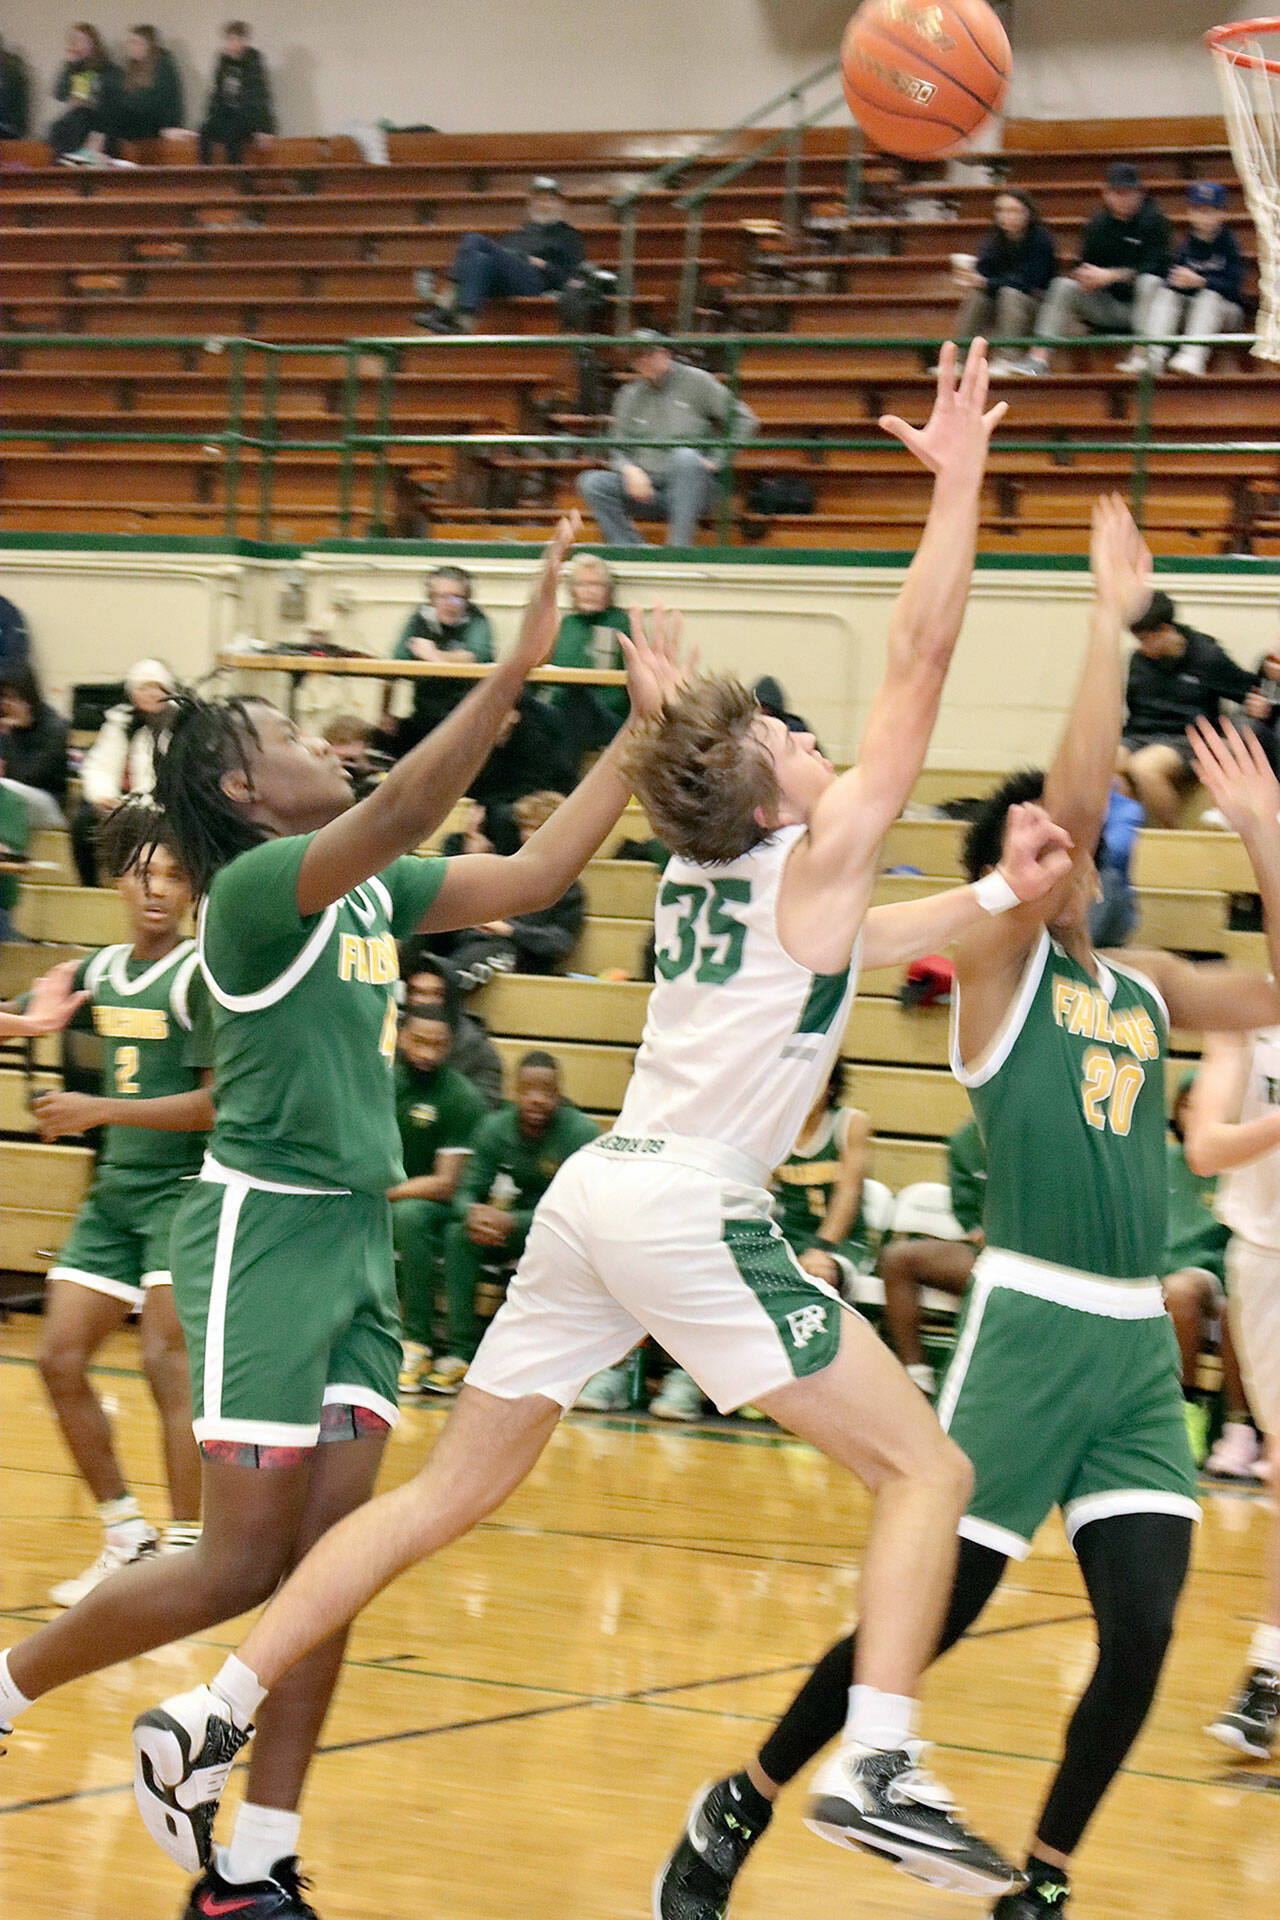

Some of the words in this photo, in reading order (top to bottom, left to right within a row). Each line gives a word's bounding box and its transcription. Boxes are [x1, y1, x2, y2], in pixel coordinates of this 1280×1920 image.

[656, 877, 752, 984] 35
[114, 1046, 140, 1093] 2
[1081, 1047, 1146, 1137] 20
